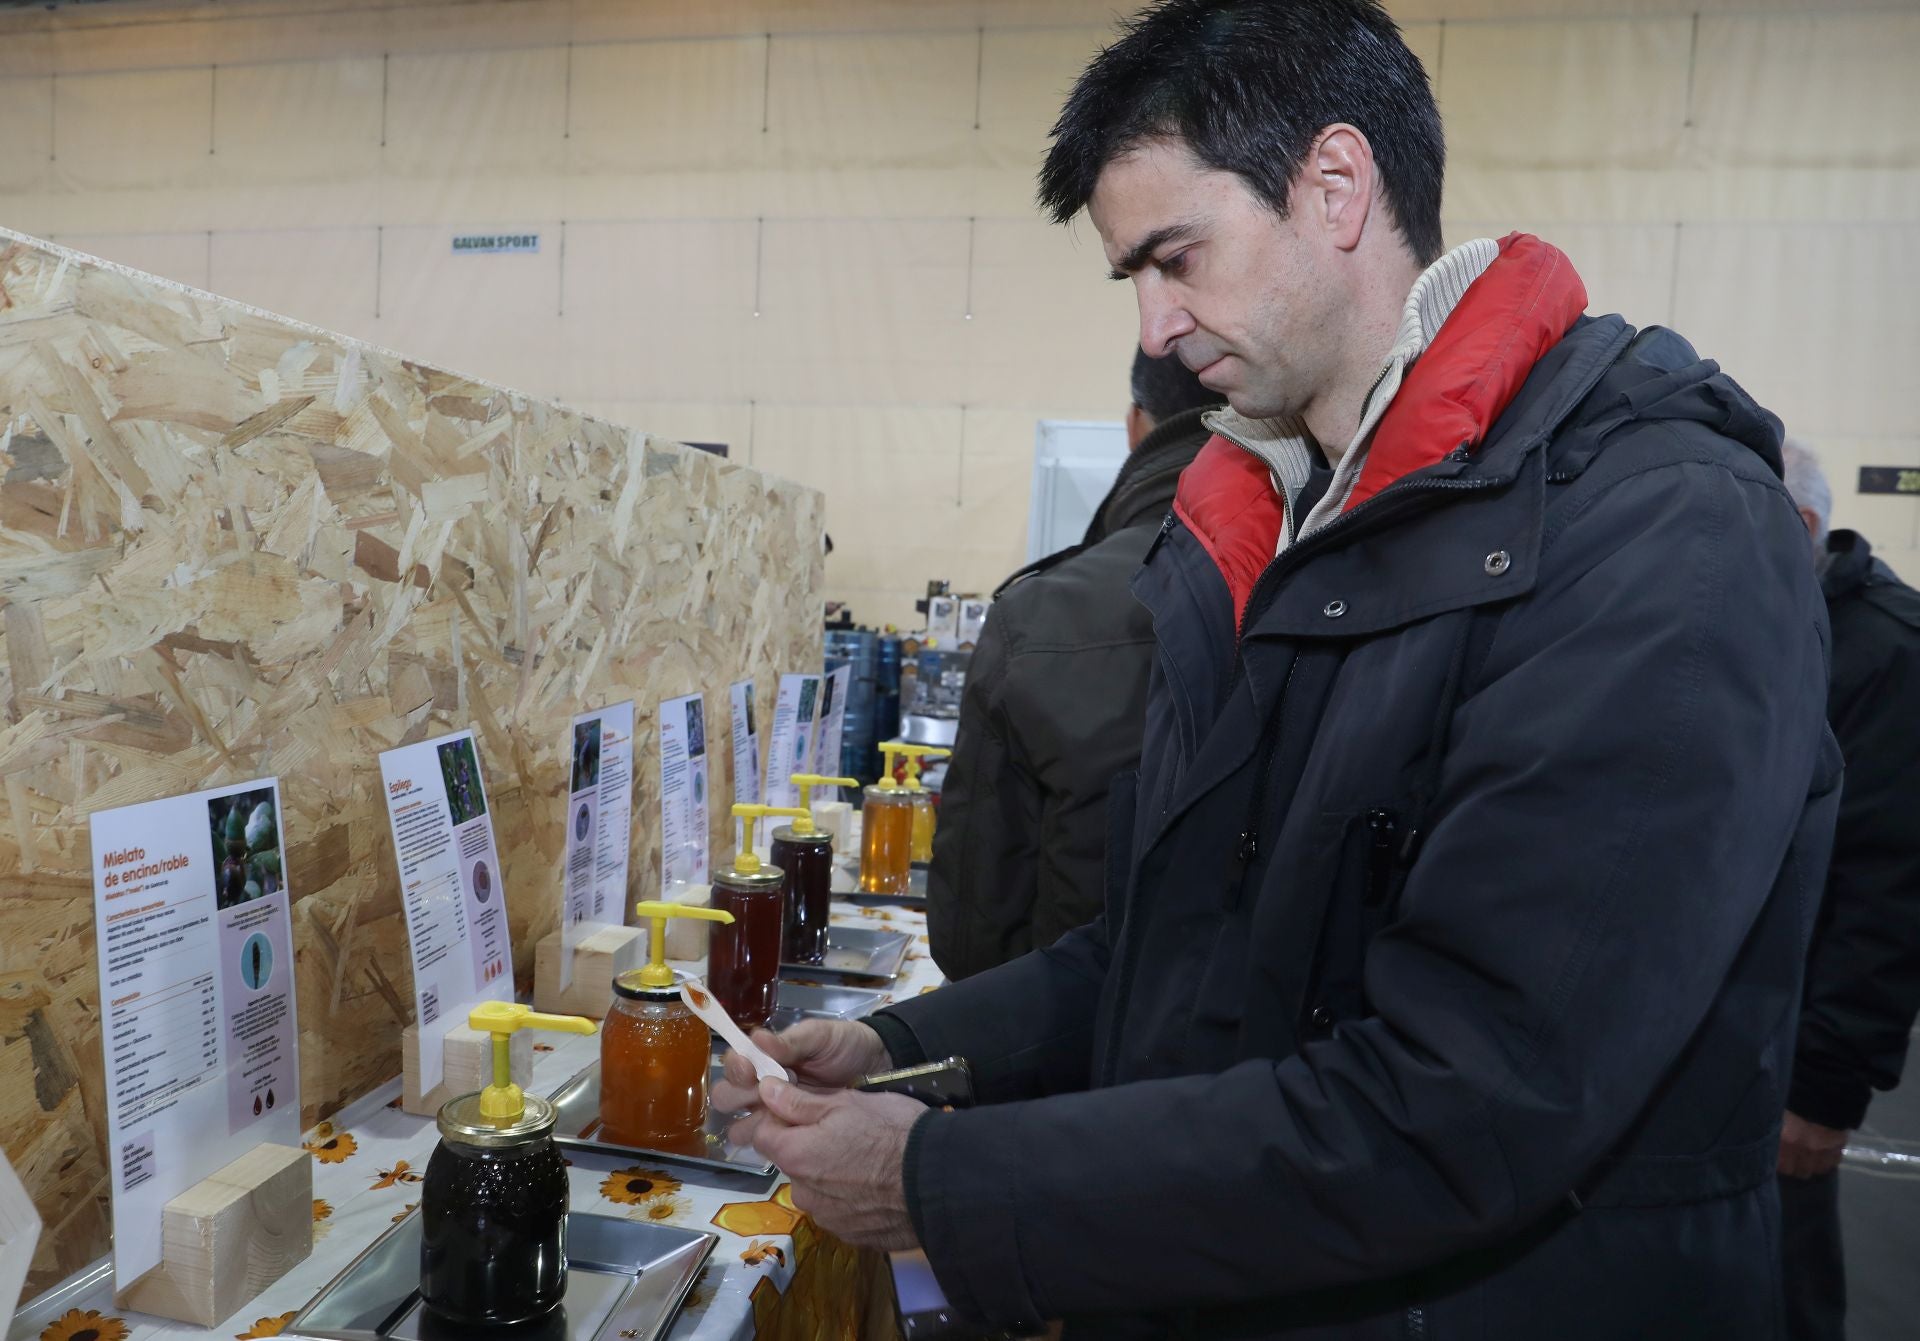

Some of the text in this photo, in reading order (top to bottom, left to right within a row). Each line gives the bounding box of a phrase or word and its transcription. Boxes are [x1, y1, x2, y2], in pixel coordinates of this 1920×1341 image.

[453, 235, 537, 249] GALVAN SPORT
[104, 847, 145, 868] Mielato
[104, 854, 189, 888] de encina/roble
